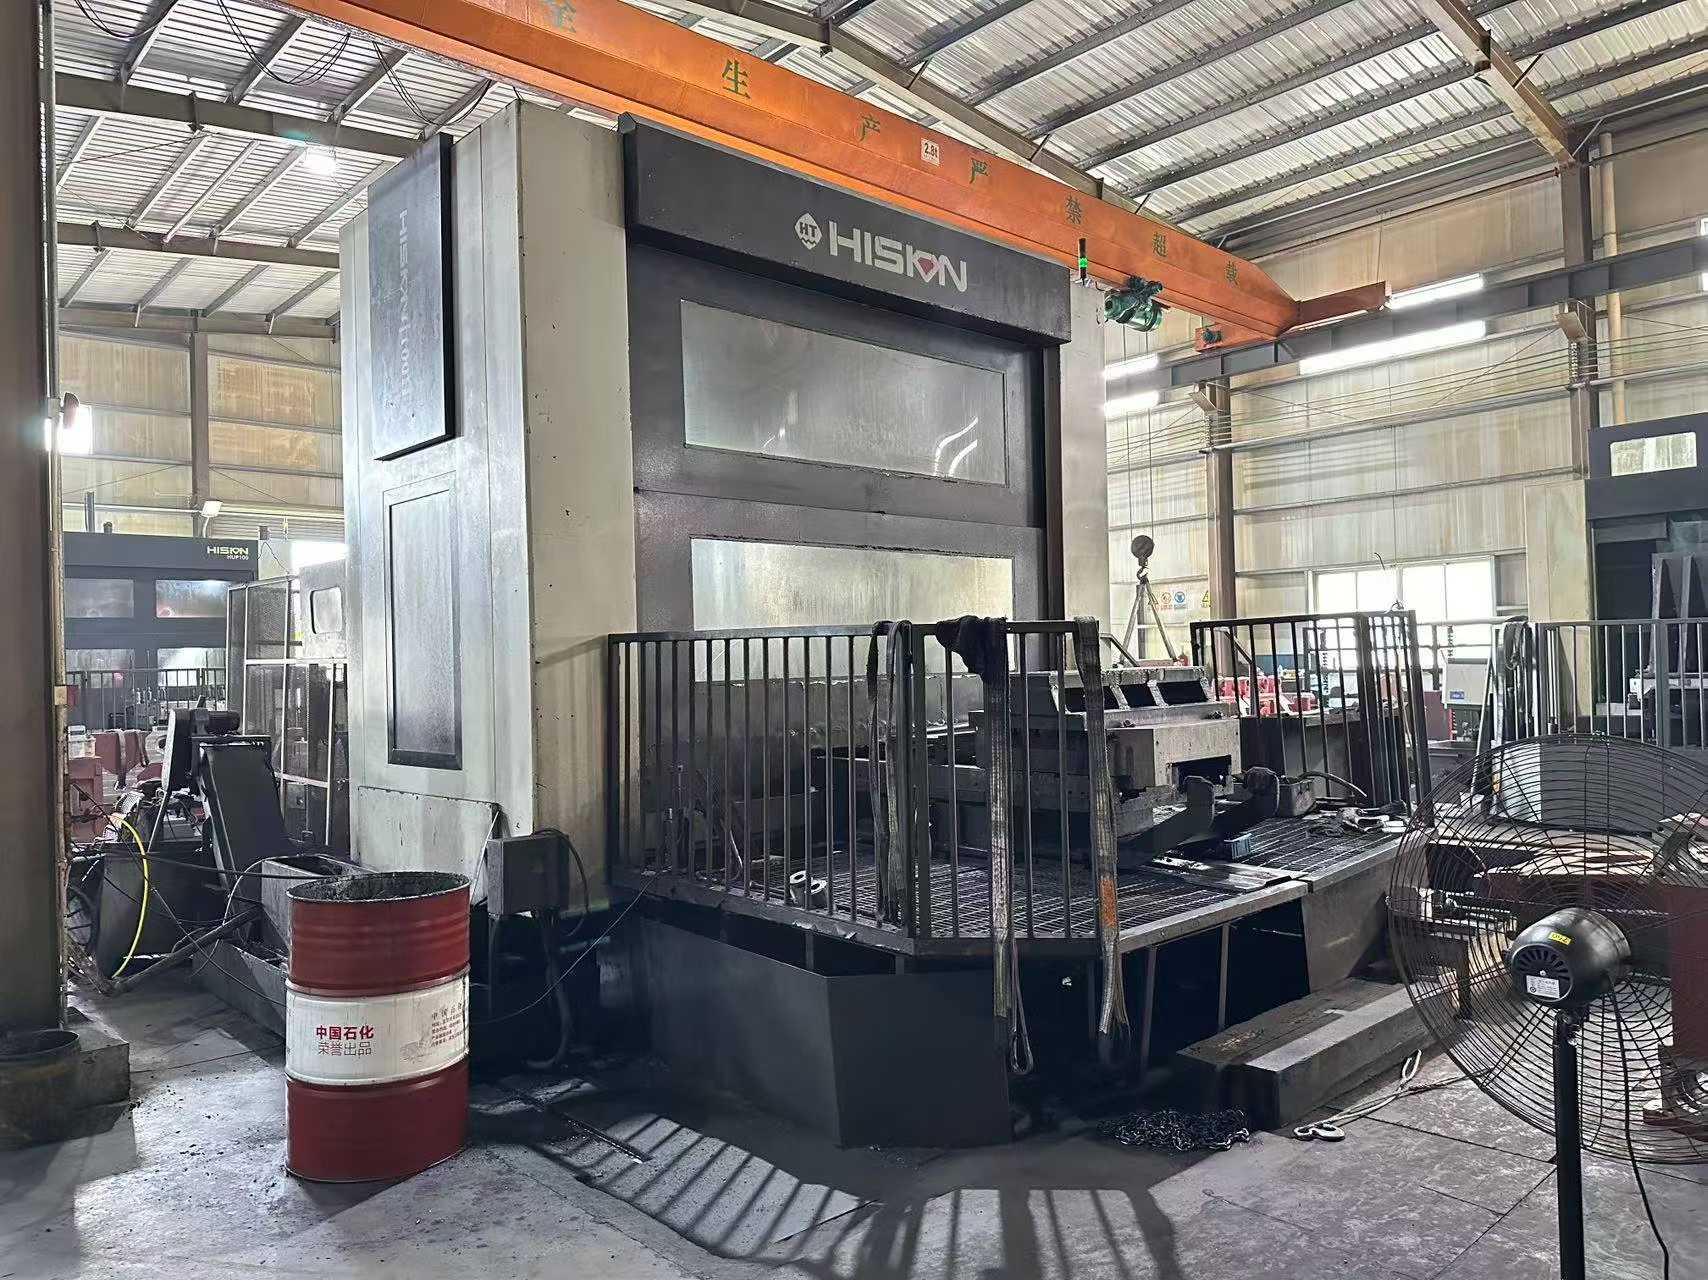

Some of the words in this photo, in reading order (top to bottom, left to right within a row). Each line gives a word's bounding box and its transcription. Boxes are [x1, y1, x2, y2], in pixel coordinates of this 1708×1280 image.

[828, 220, 968, 292] HISION
[207, 546, 249, 555] HISION
[316, 1025, 374, 1040] 中国石化
[317, 1041, 373, 1056] 荣誉出品
